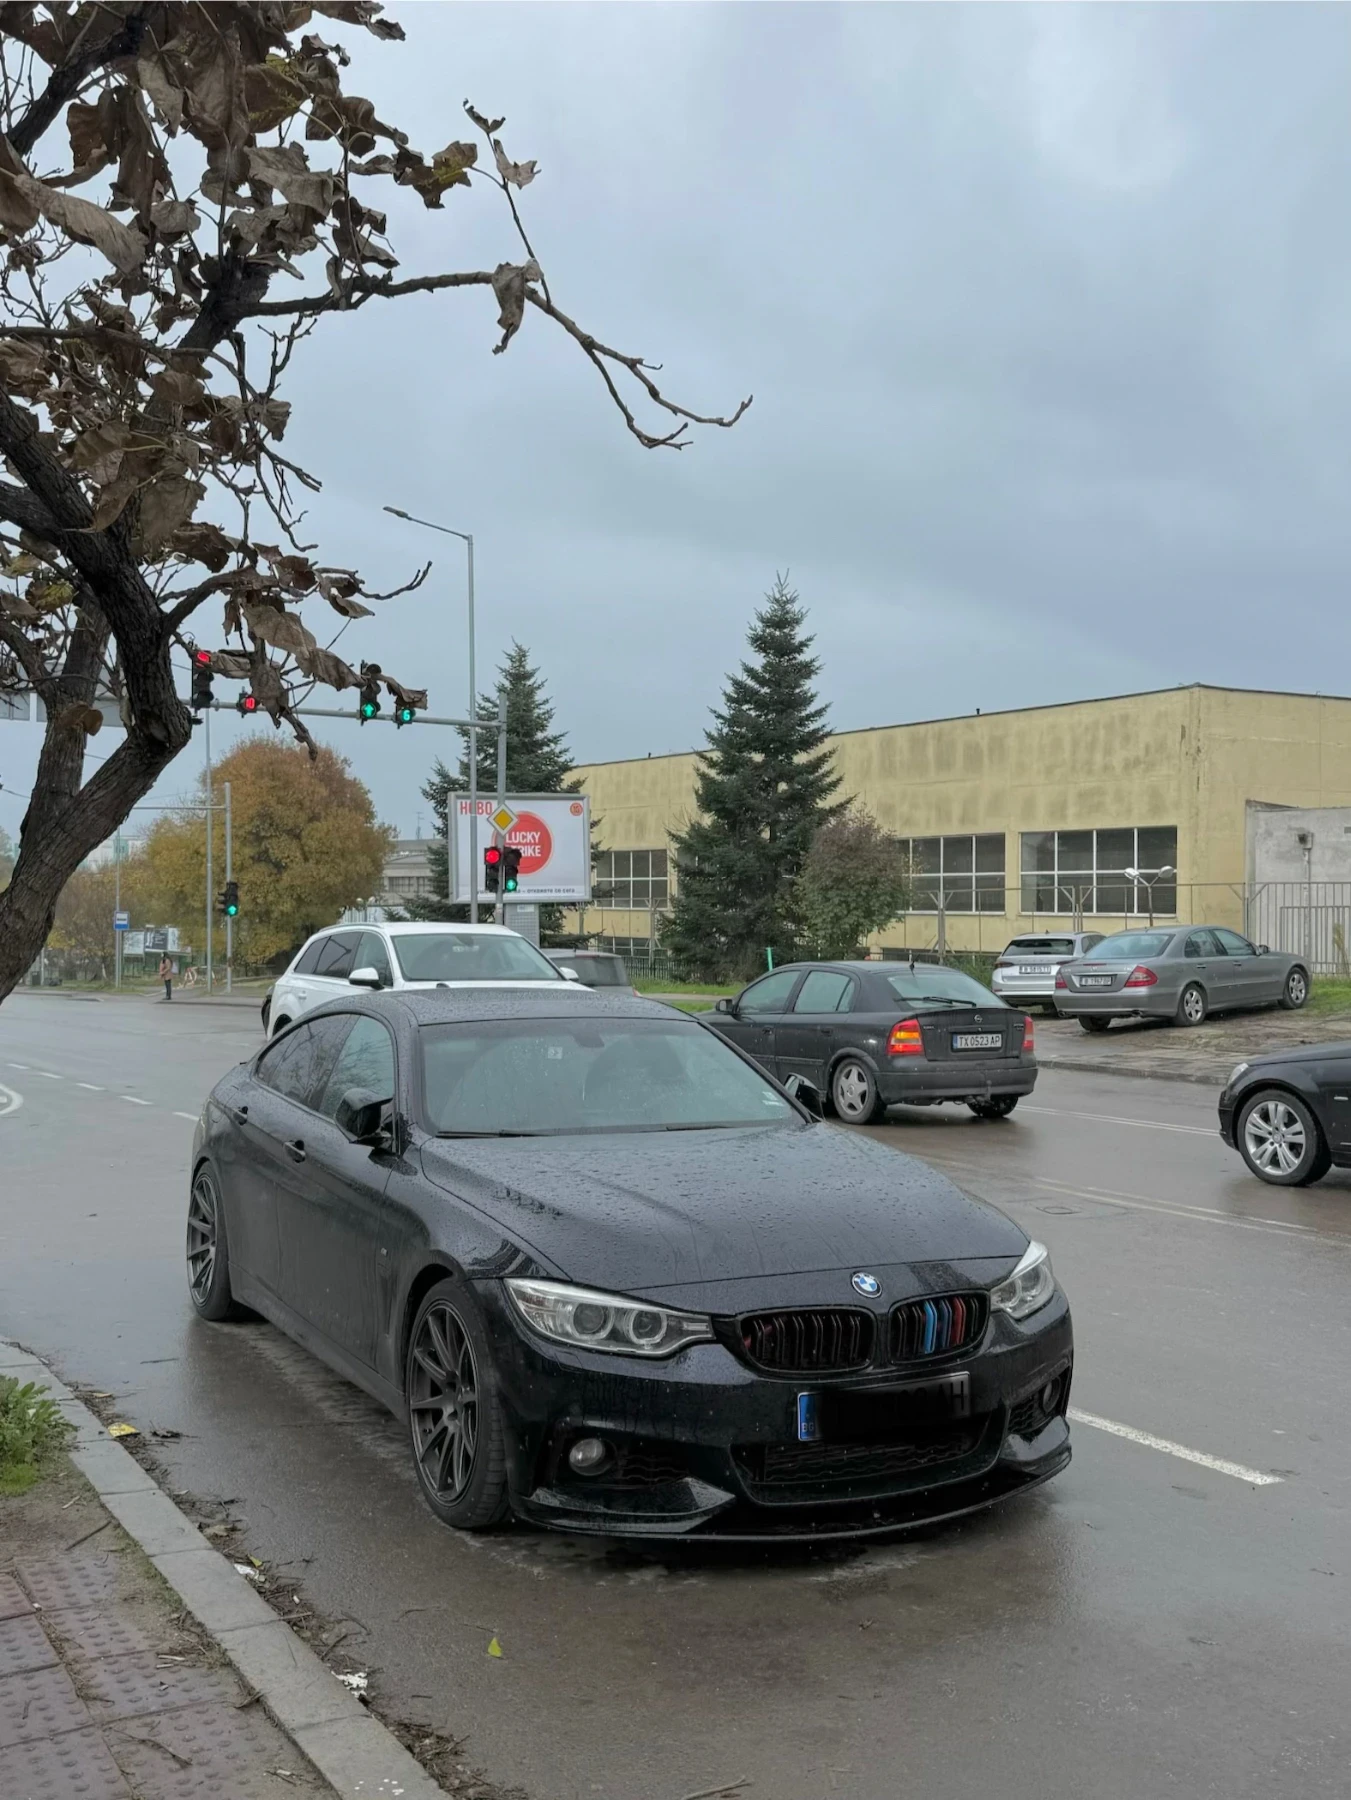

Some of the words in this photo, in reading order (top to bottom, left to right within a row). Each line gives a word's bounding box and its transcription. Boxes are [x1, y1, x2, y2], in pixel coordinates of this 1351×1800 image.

[403, 709, 411, 721] 6
[505, 831, 541, 843] LUCKY
[504, 844, 542, 857] RIKE
[801, 1422, 814, 1432] BG
